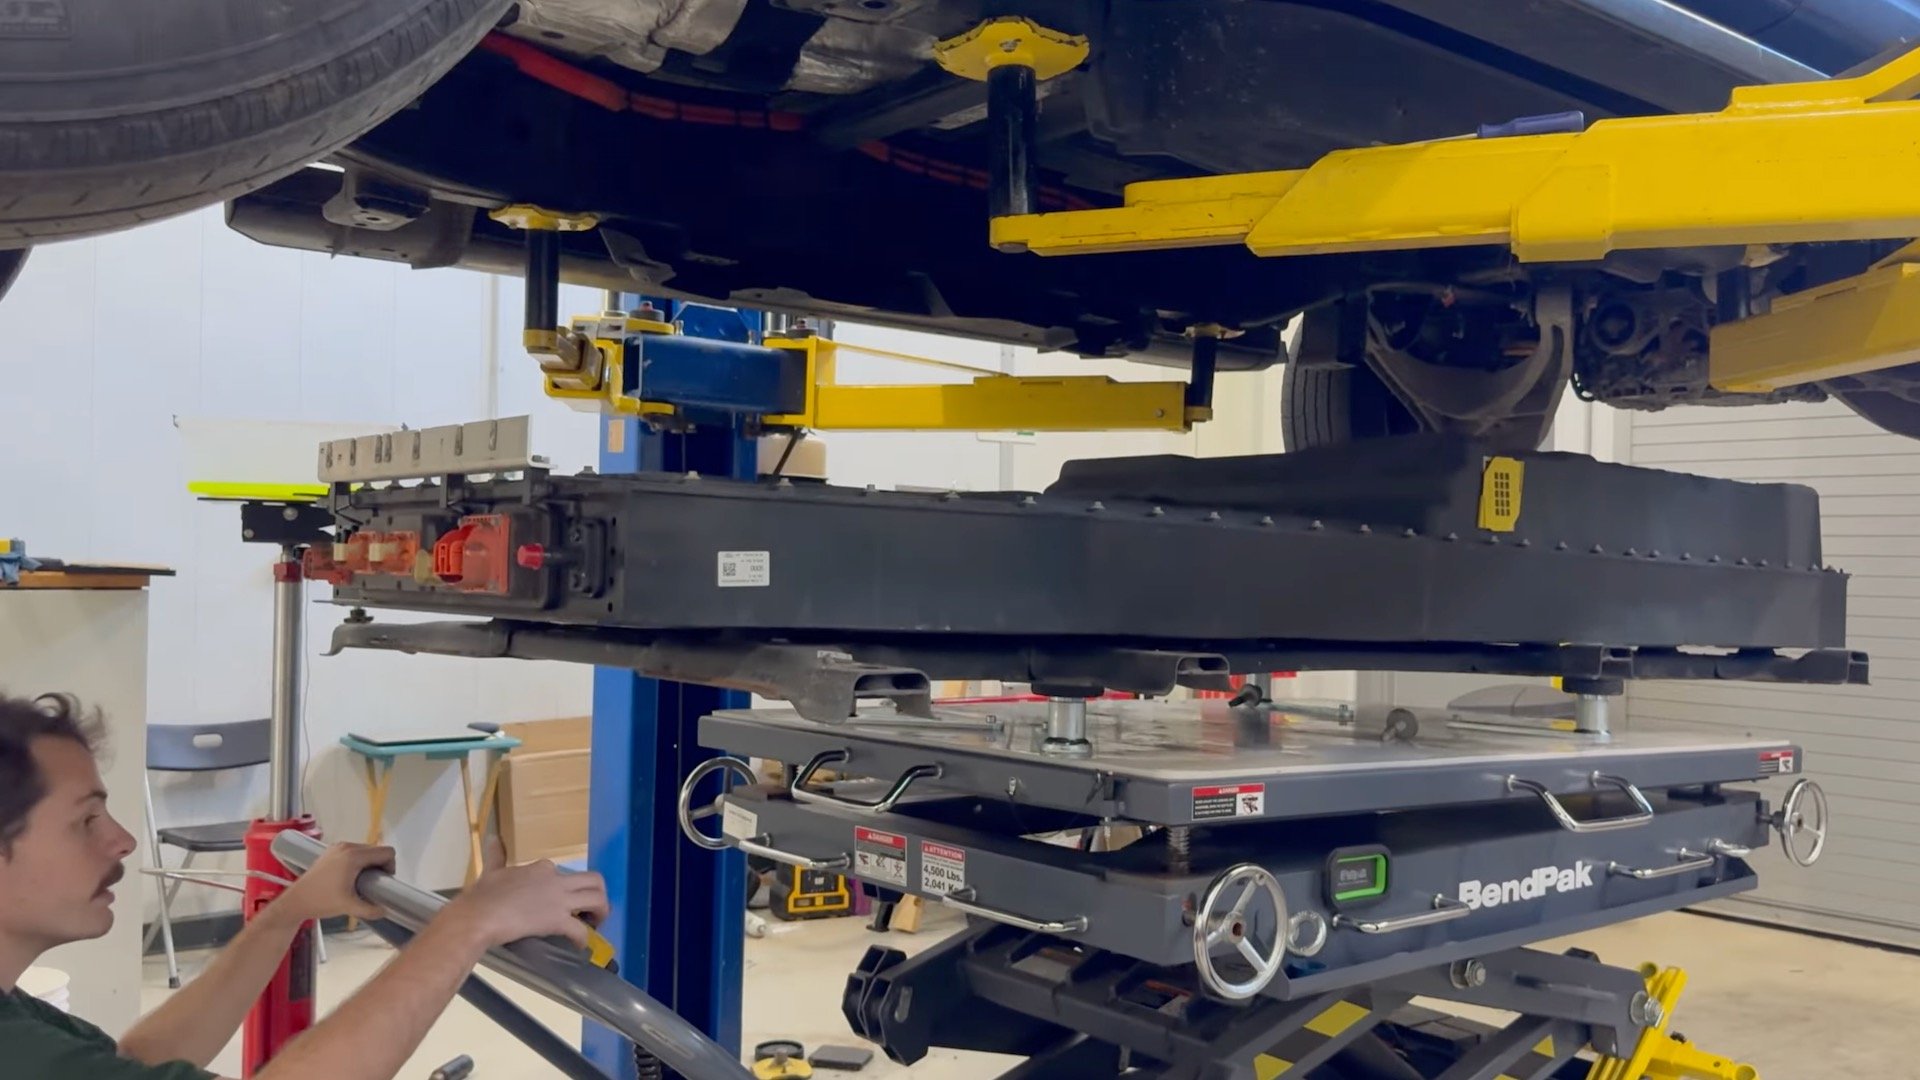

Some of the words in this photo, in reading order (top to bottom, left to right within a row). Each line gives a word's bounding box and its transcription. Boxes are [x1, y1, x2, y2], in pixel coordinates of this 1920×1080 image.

[929, 846, 963, 860] ATTENTION
[923, 864, 945, 878] 4,500
[946, 870, 963, 882] Lbs.
[924, 877, 945, 890] 2,041
[1459, 860, 1594, 910] BendPak
